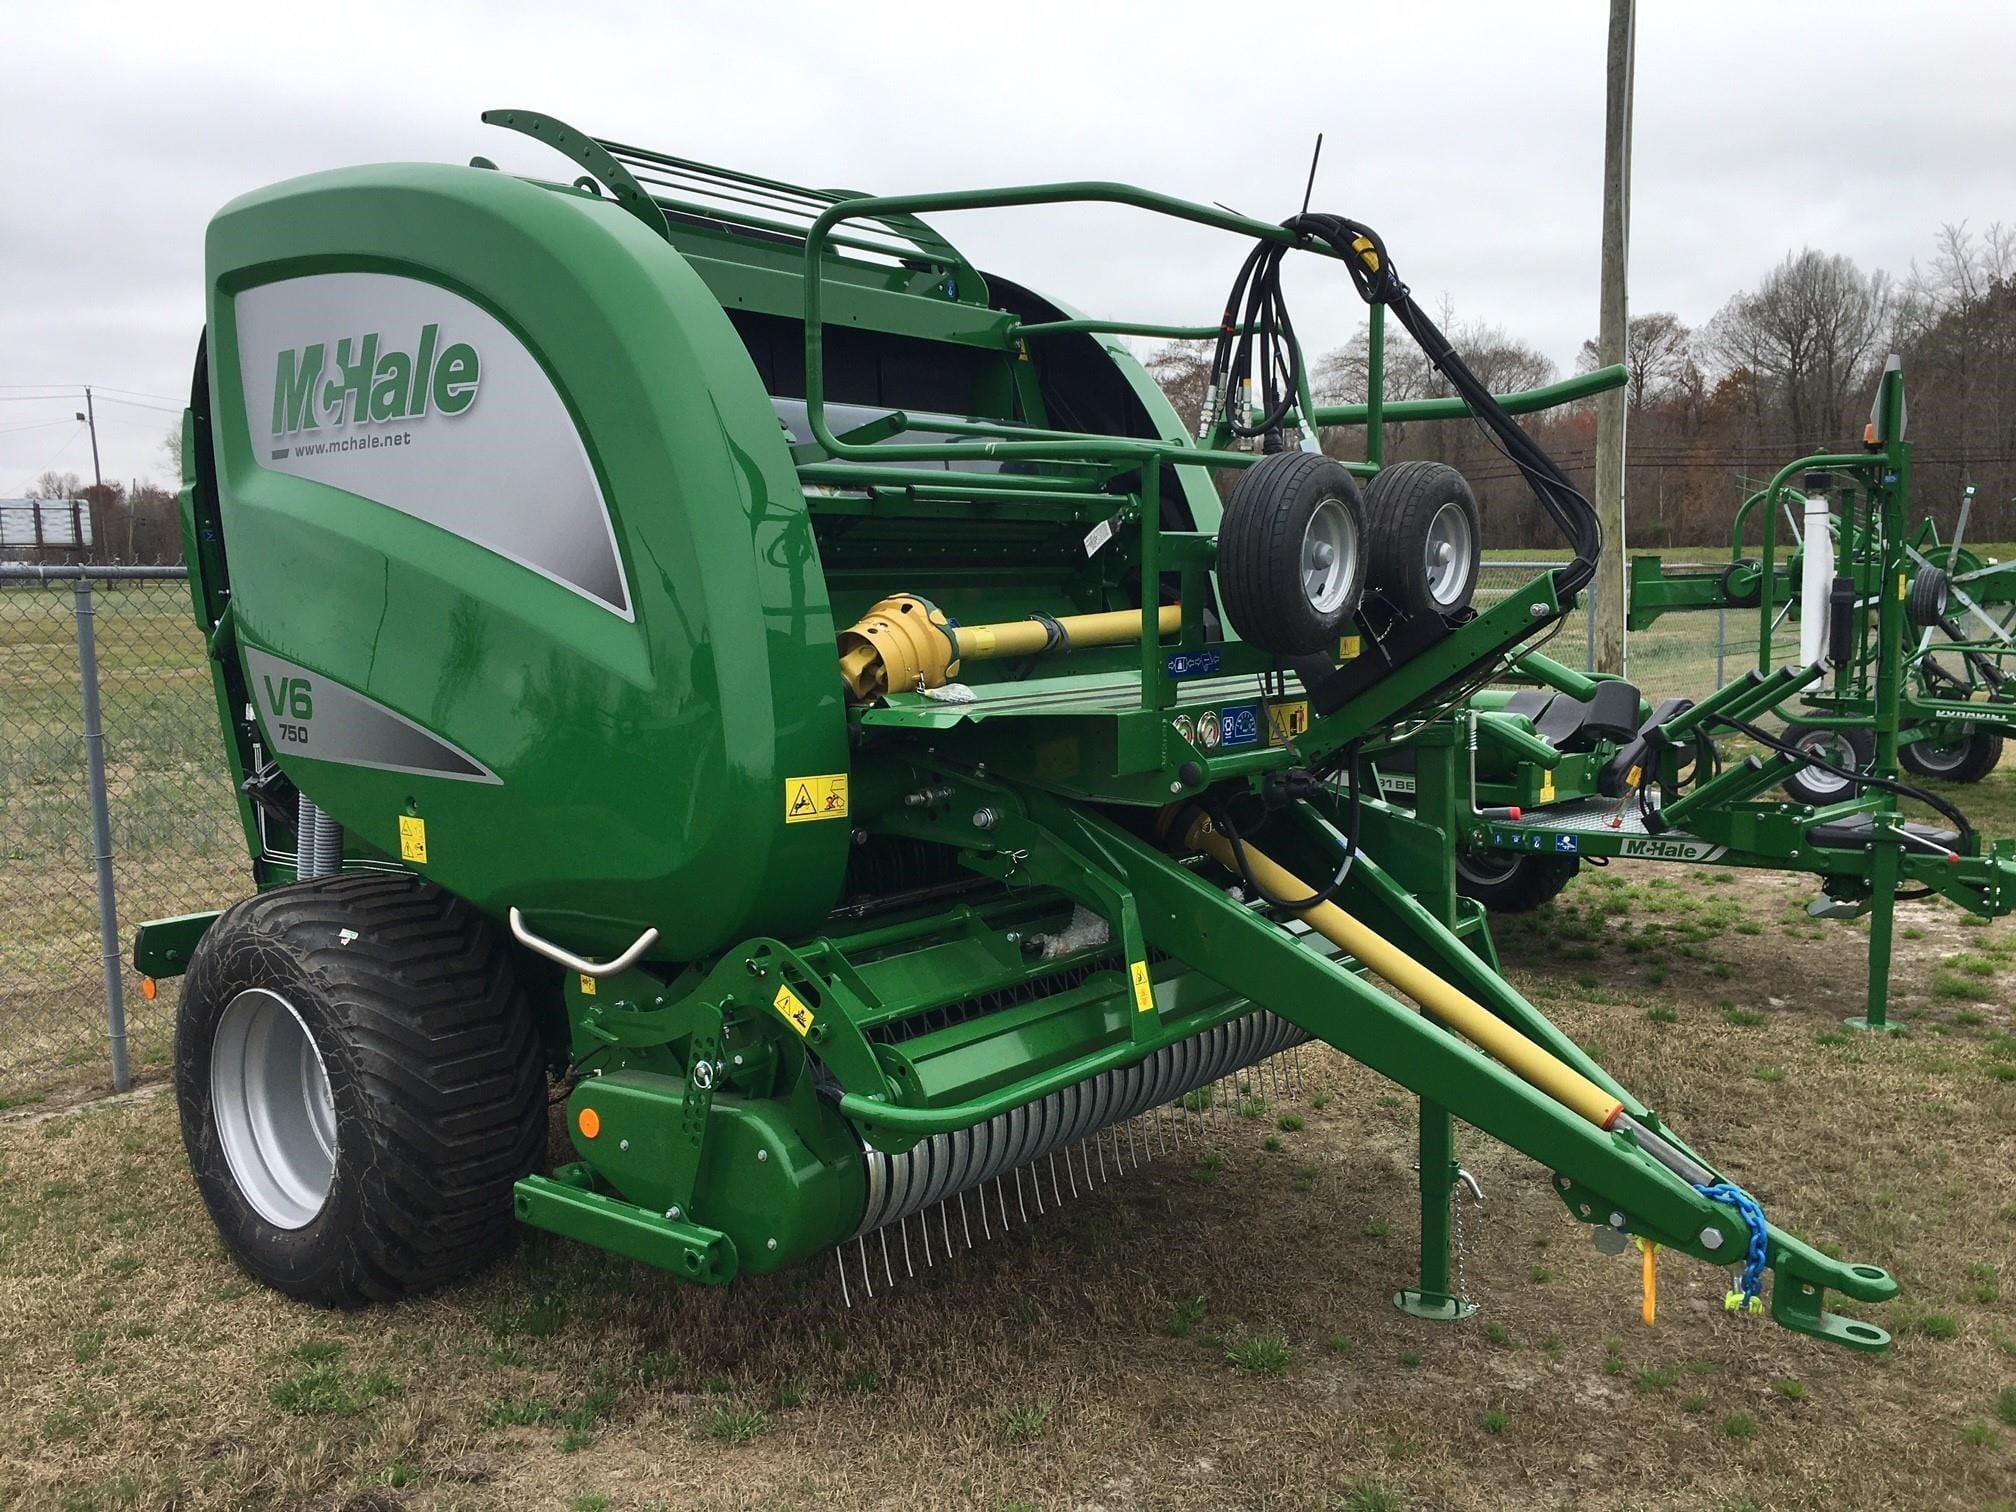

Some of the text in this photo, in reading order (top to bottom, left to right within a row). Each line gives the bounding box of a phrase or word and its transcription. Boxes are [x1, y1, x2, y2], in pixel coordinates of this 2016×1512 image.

[272, 323, 481, 436] McHale
[295, 431, 411, 457] www.mchale.net
[264, 675, 312, 720] V6
[279, 724, 308, 744] 750
[1396, 781, 1414, 791] BE
[1626, 840, 1697, 858] McHale
